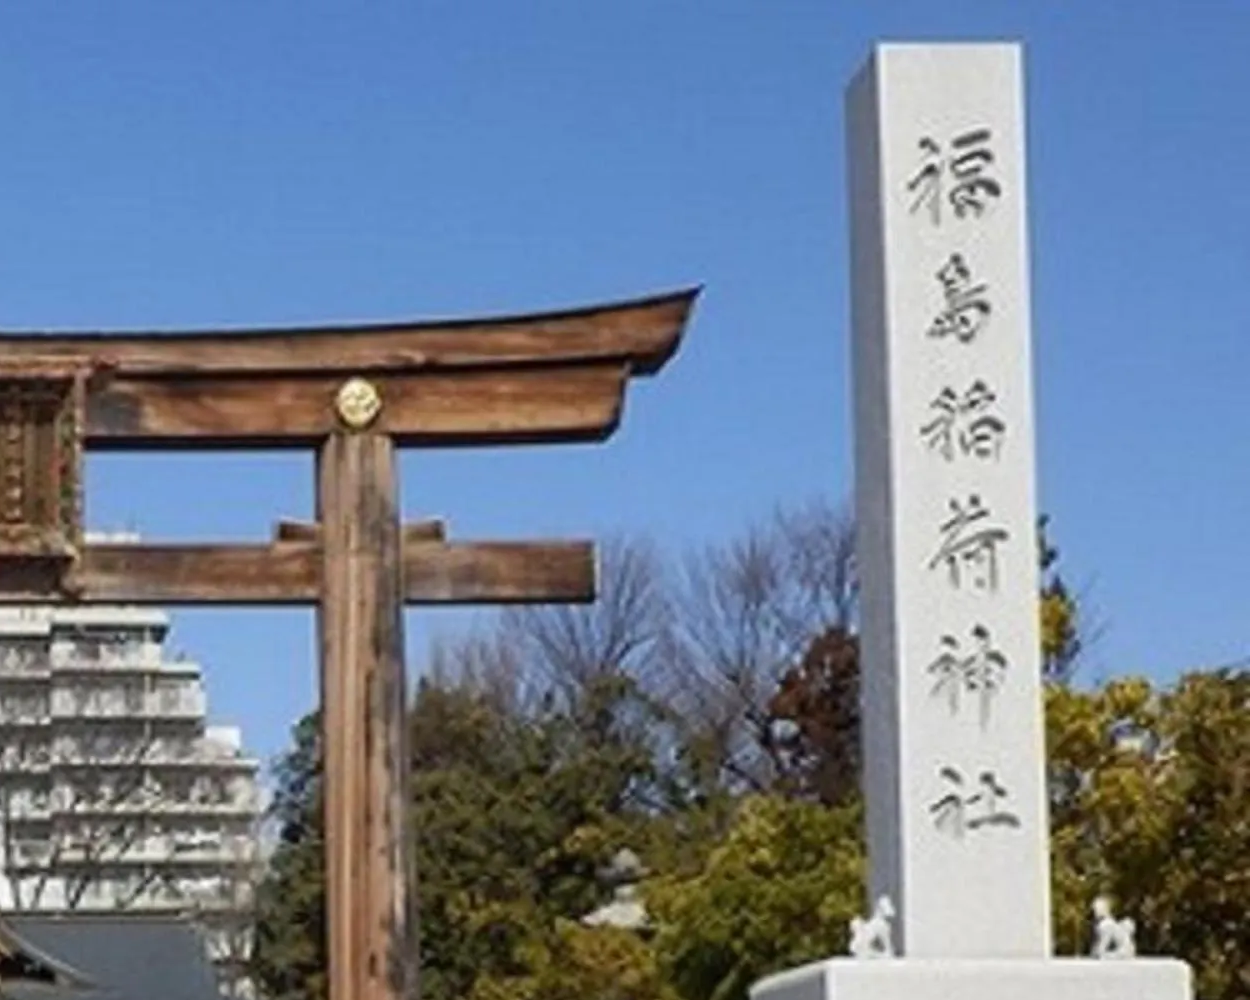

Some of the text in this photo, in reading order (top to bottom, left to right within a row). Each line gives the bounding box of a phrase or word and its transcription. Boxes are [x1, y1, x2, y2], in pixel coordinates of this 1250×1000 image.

[907, 129, 1020, 839] 福島稲荷神社
